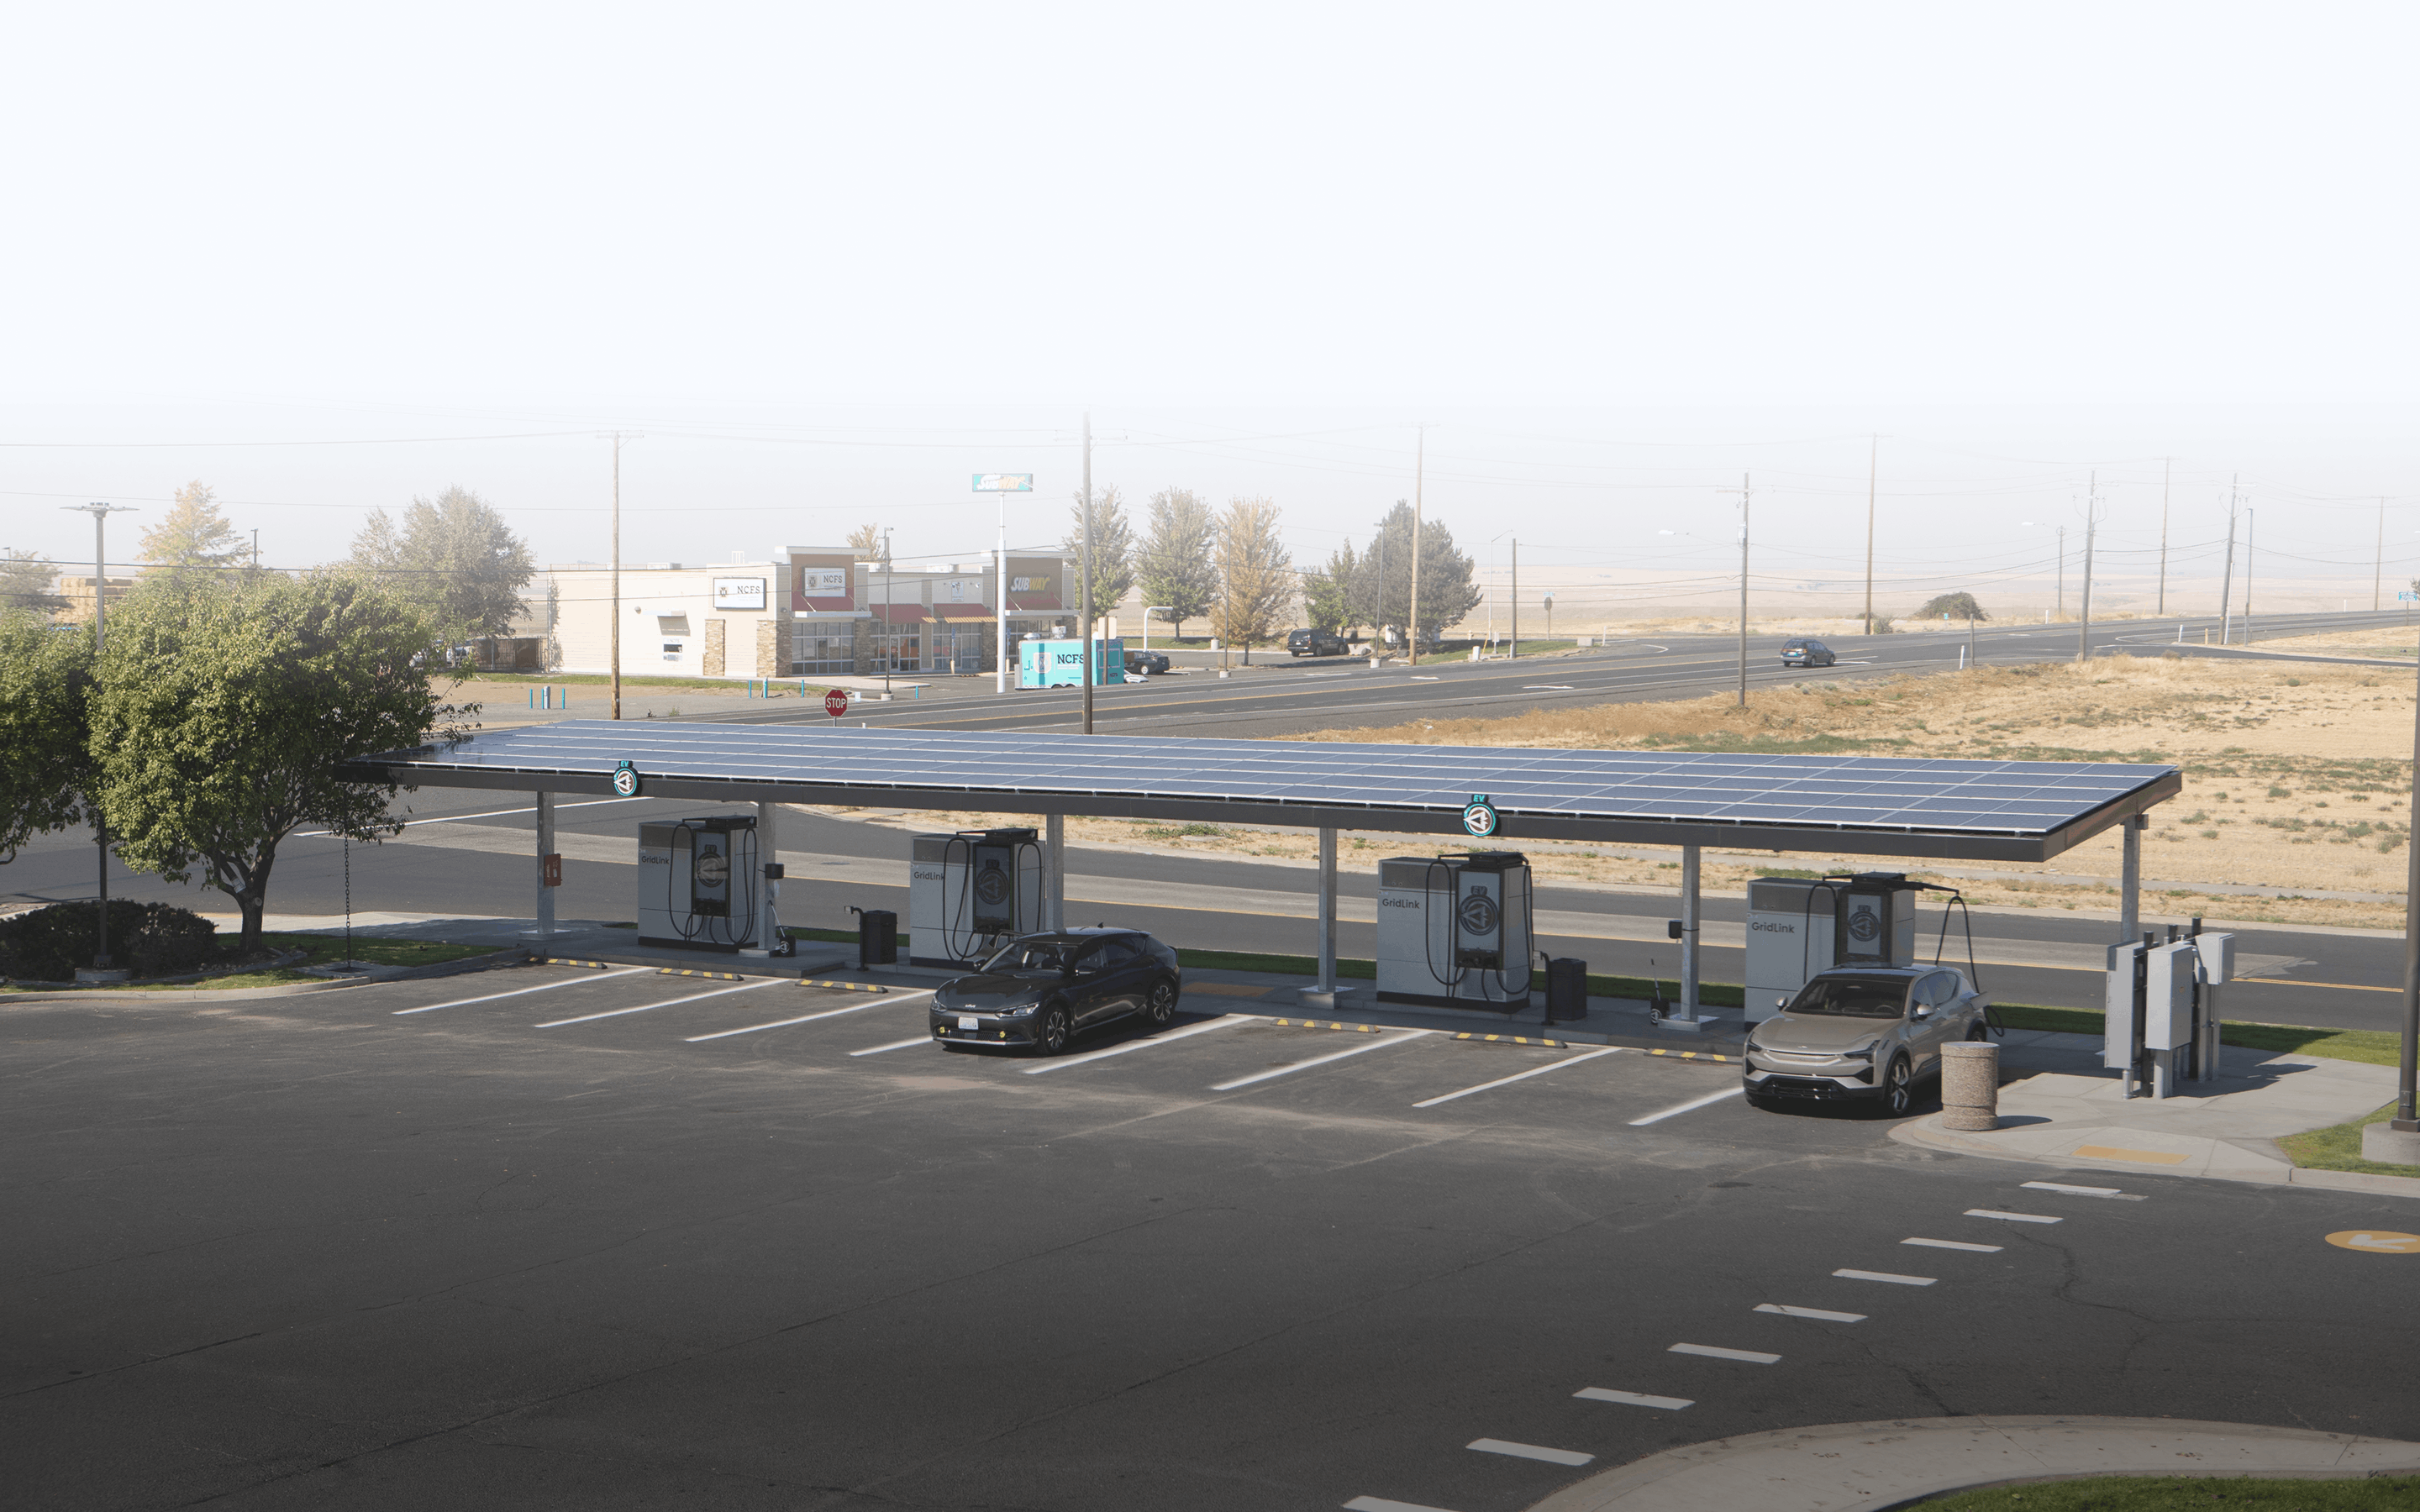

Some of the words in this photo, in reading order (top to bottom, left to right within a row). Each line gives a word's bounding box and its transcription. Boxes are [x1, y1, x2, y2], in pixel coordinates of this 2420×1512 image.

[976, 475, 1026, 490] SUBWAY
[1011, 575, 1050, 591] SUBWAY
[737, 585, 760, 594] NCFS
[1057, 654, 1084, 664] NCFS
[826, 697, 846, 708] STOP
[641, 855, 670, 864] GridLink
[913, 870, 944, 880] GridLink
[1382, 898, 1420, 909] GridLink
[1751, 921, 1795, 933] GridLink
